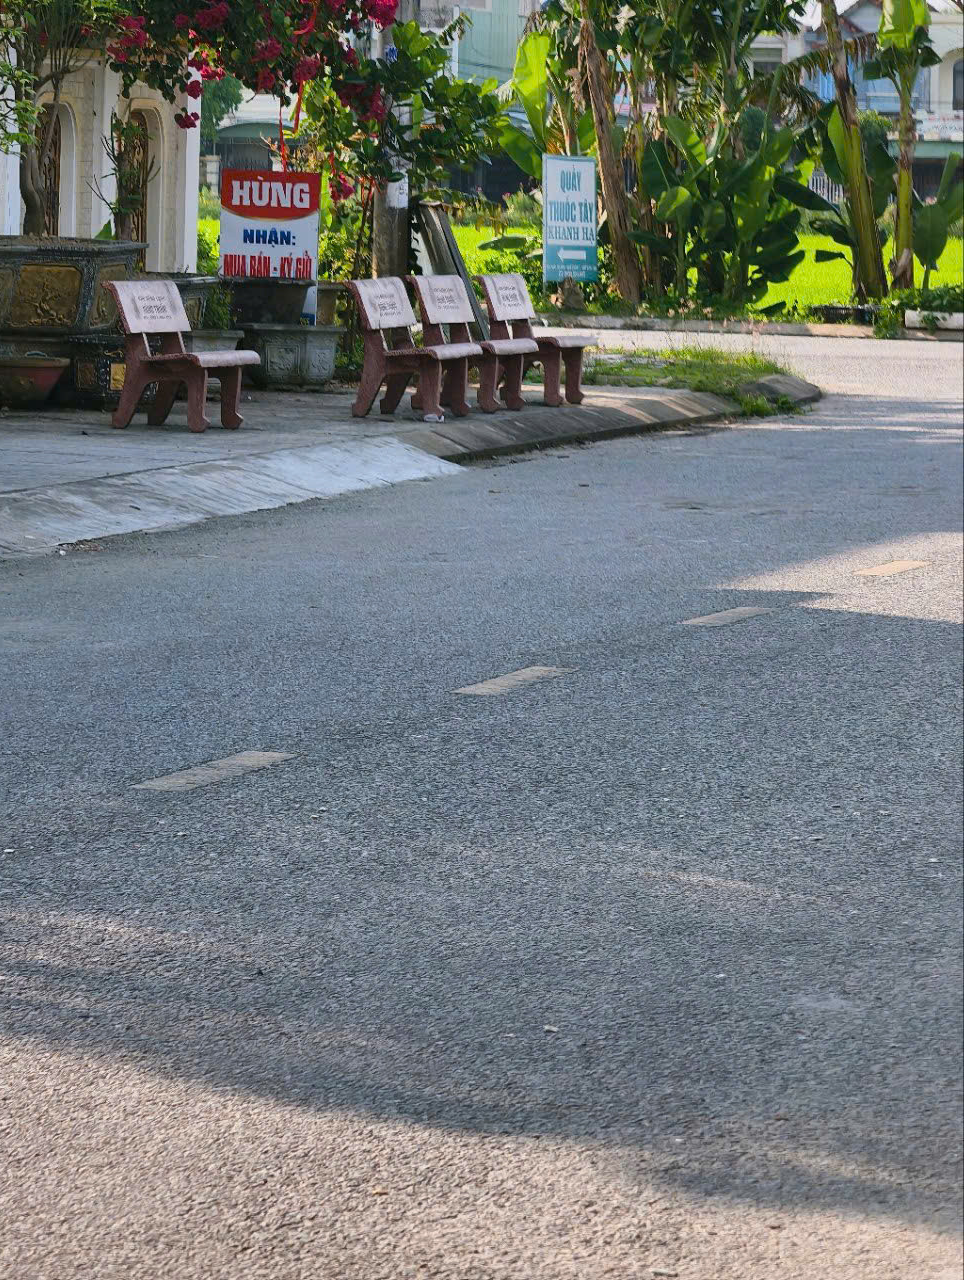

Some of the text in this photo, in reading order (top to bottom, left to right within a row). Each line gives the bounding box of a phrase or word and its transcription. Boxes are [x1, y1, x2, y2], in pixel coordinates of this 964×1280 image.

[231, 176, 310, 209] HÙNG
[243, 227, 296, 248] NHẬN:
[223, 253, 246, 277] MUA
[249, 251, 270, 278] BÁN
